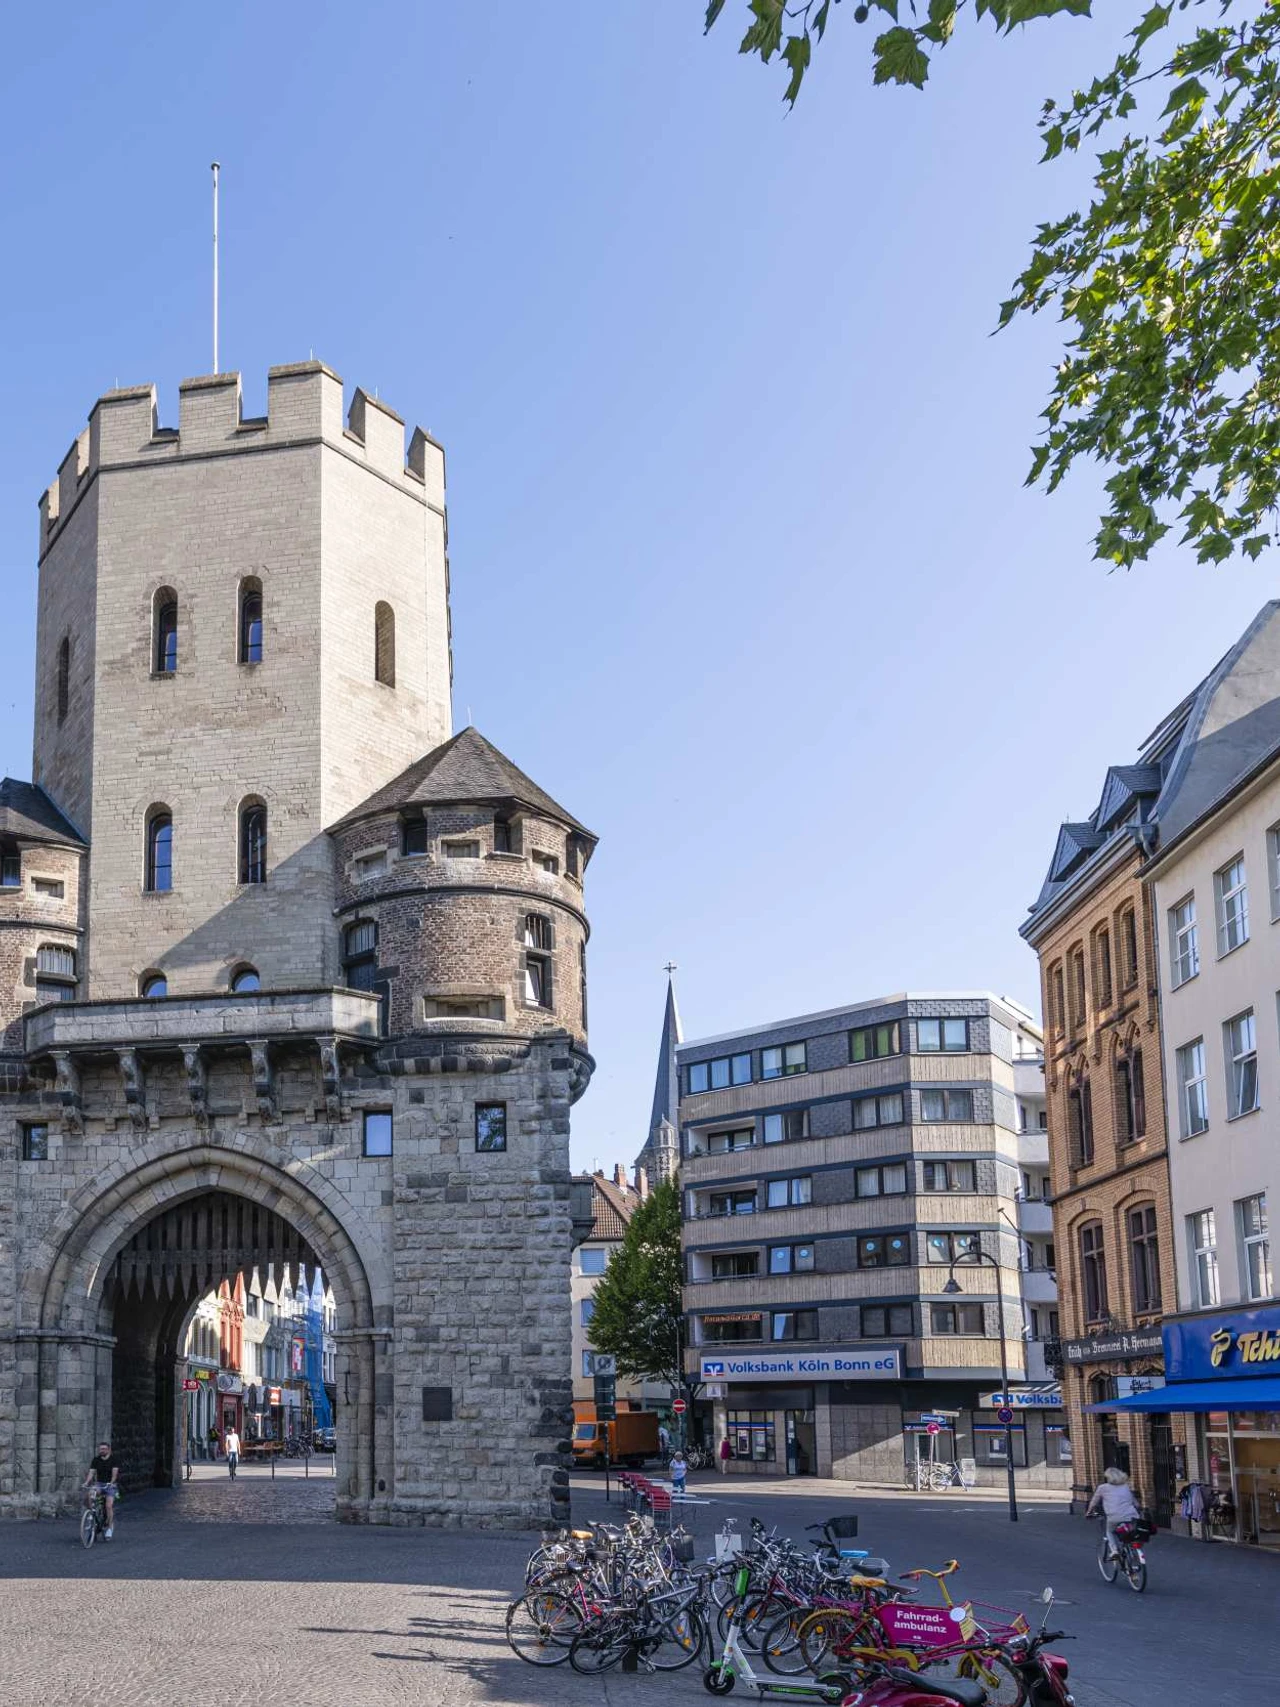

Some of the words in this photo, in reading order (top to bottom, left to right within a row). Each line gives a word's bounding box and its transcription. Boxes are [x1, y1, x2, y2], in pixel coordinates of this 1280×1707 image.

[728, 1360, 794, 1374] Volksbank
[799, 1359, 829, 1372] Köln
[834, 1359, 870, 1371] Bonn
[874, 1357, 895, 1370] eG
[896, 1611, 944, 1622] Fahrrad-
[894, 1621, 947, 1633] ambulanz
